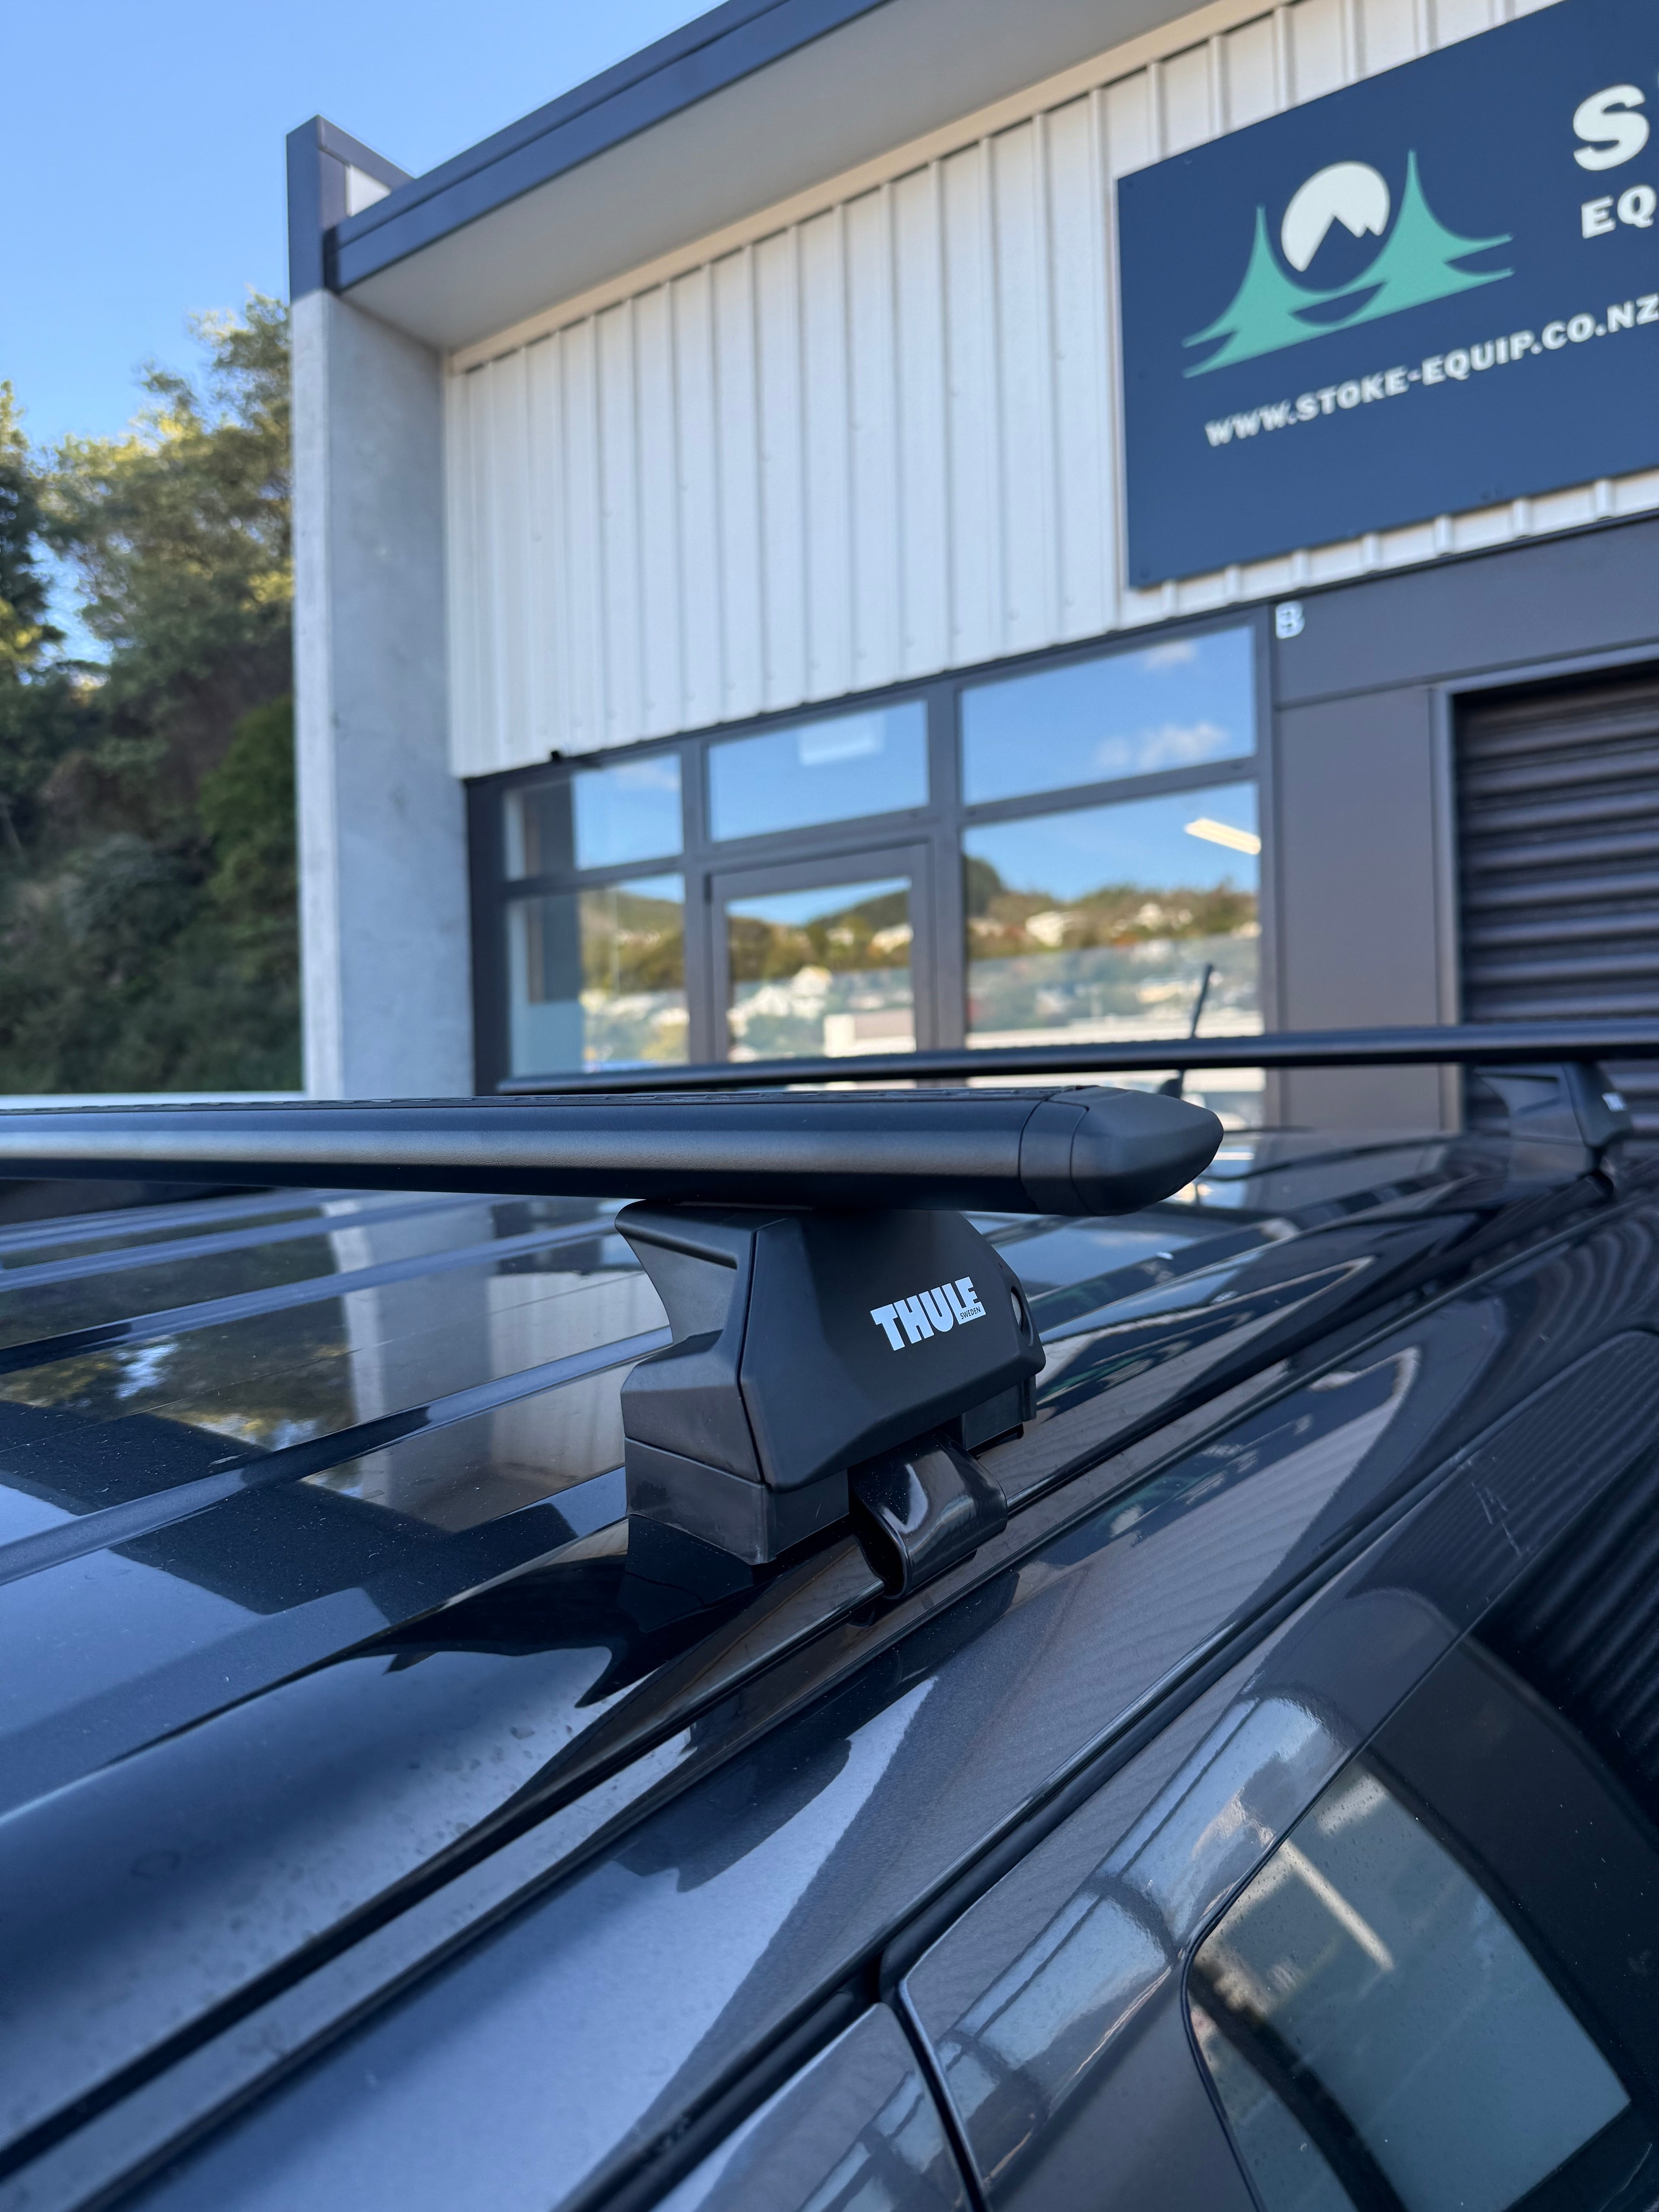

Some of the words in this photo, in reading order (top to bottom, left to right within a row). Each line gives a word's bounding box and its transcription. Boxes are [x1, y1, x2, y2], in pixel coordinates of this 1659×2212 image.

[1573, 76, 1659, 171] S
[1581, 184, 1657, 238] EQ
[1205, 292, 1659, 447] WWW.STOKE-EQUIP.CO.NZ
[1275, 600, 1305, 639] B
[870, 1277, 986, 1351] THULE
[960, 1306, 981, 1319] SWEDEN
